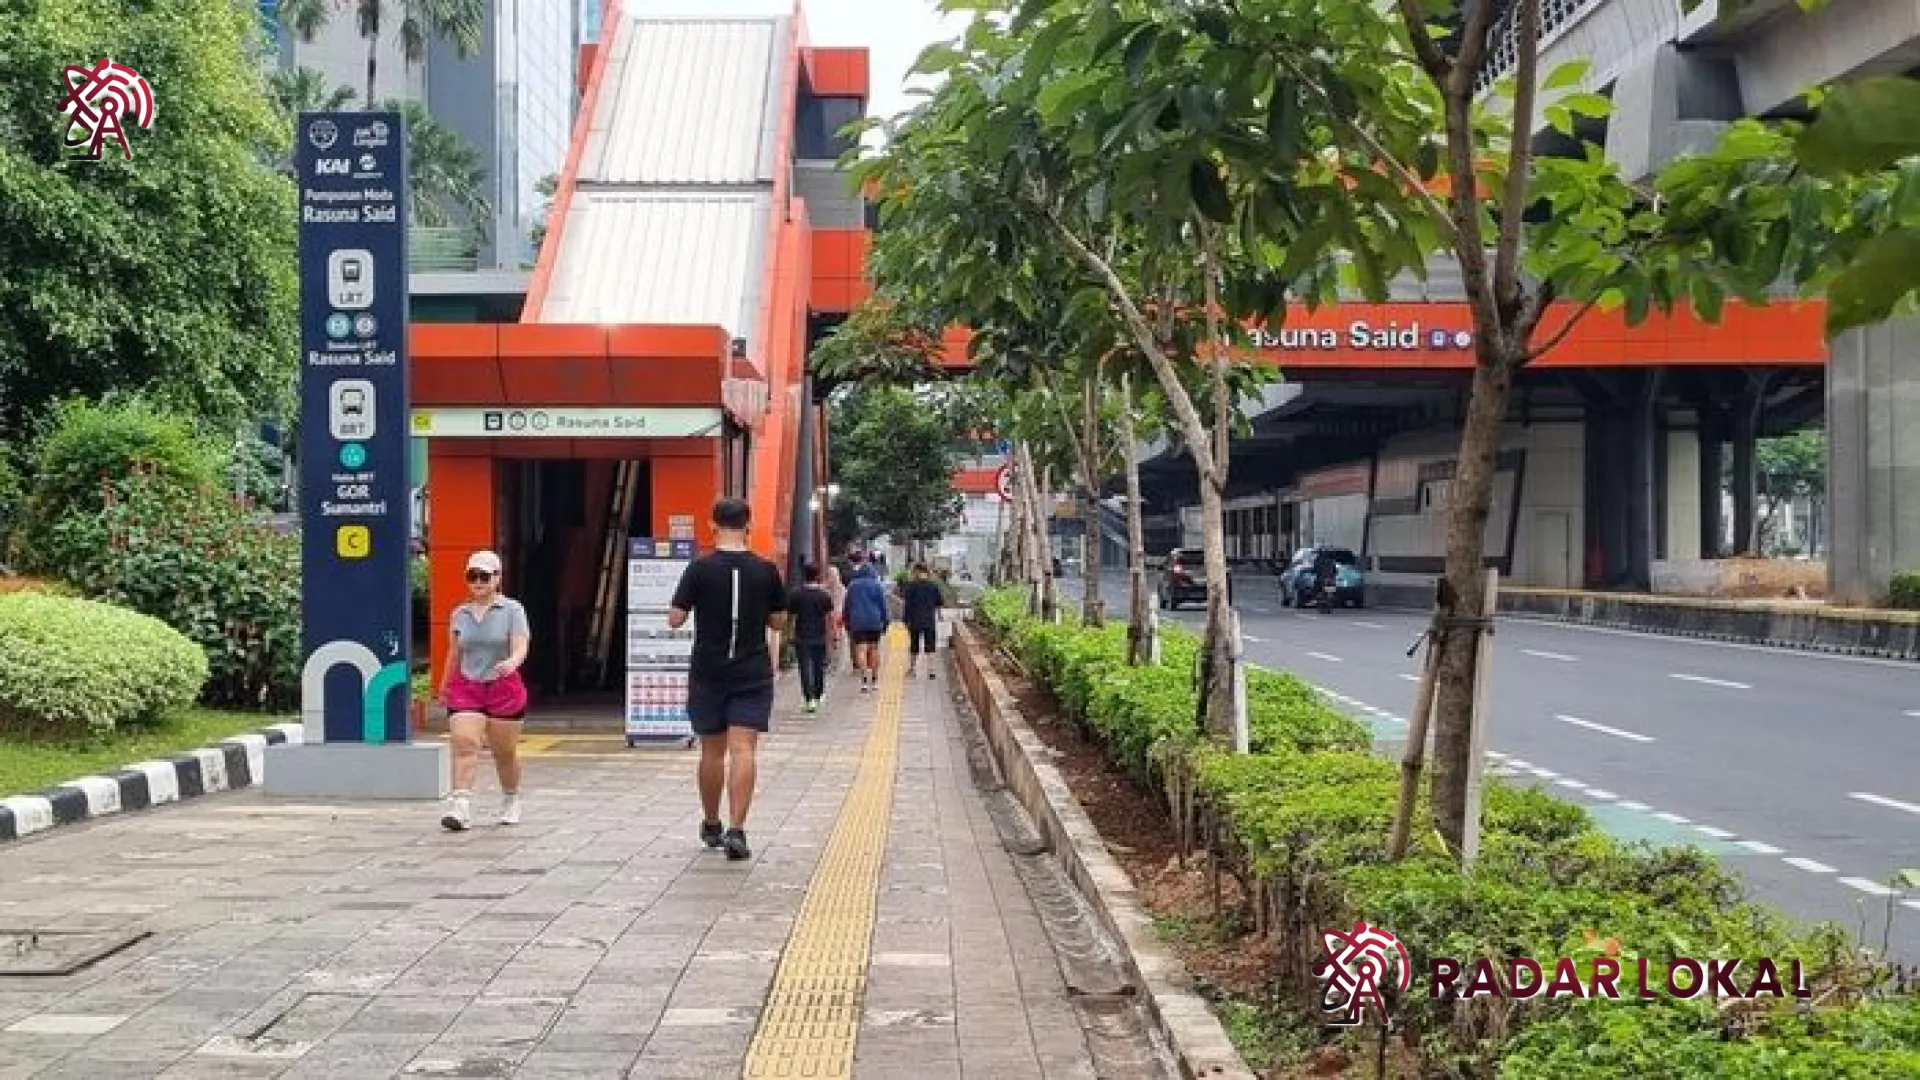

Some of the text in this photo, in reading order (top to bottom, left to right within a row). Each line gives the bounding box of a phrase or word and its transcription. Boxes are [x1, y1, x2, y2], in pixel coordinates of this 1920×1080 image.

[303, 205, 396, 222] Rasuna Said
[1350, 319, 1420, 348] Said
[309, 351, 396, 365] Rasuna Said
[556, 416, 646, 429] Rasuna Said
[337, 485, 370, 499] GOR
[321, 500, 388, 515] Sumantri
[348, 532, 360, 549] C
